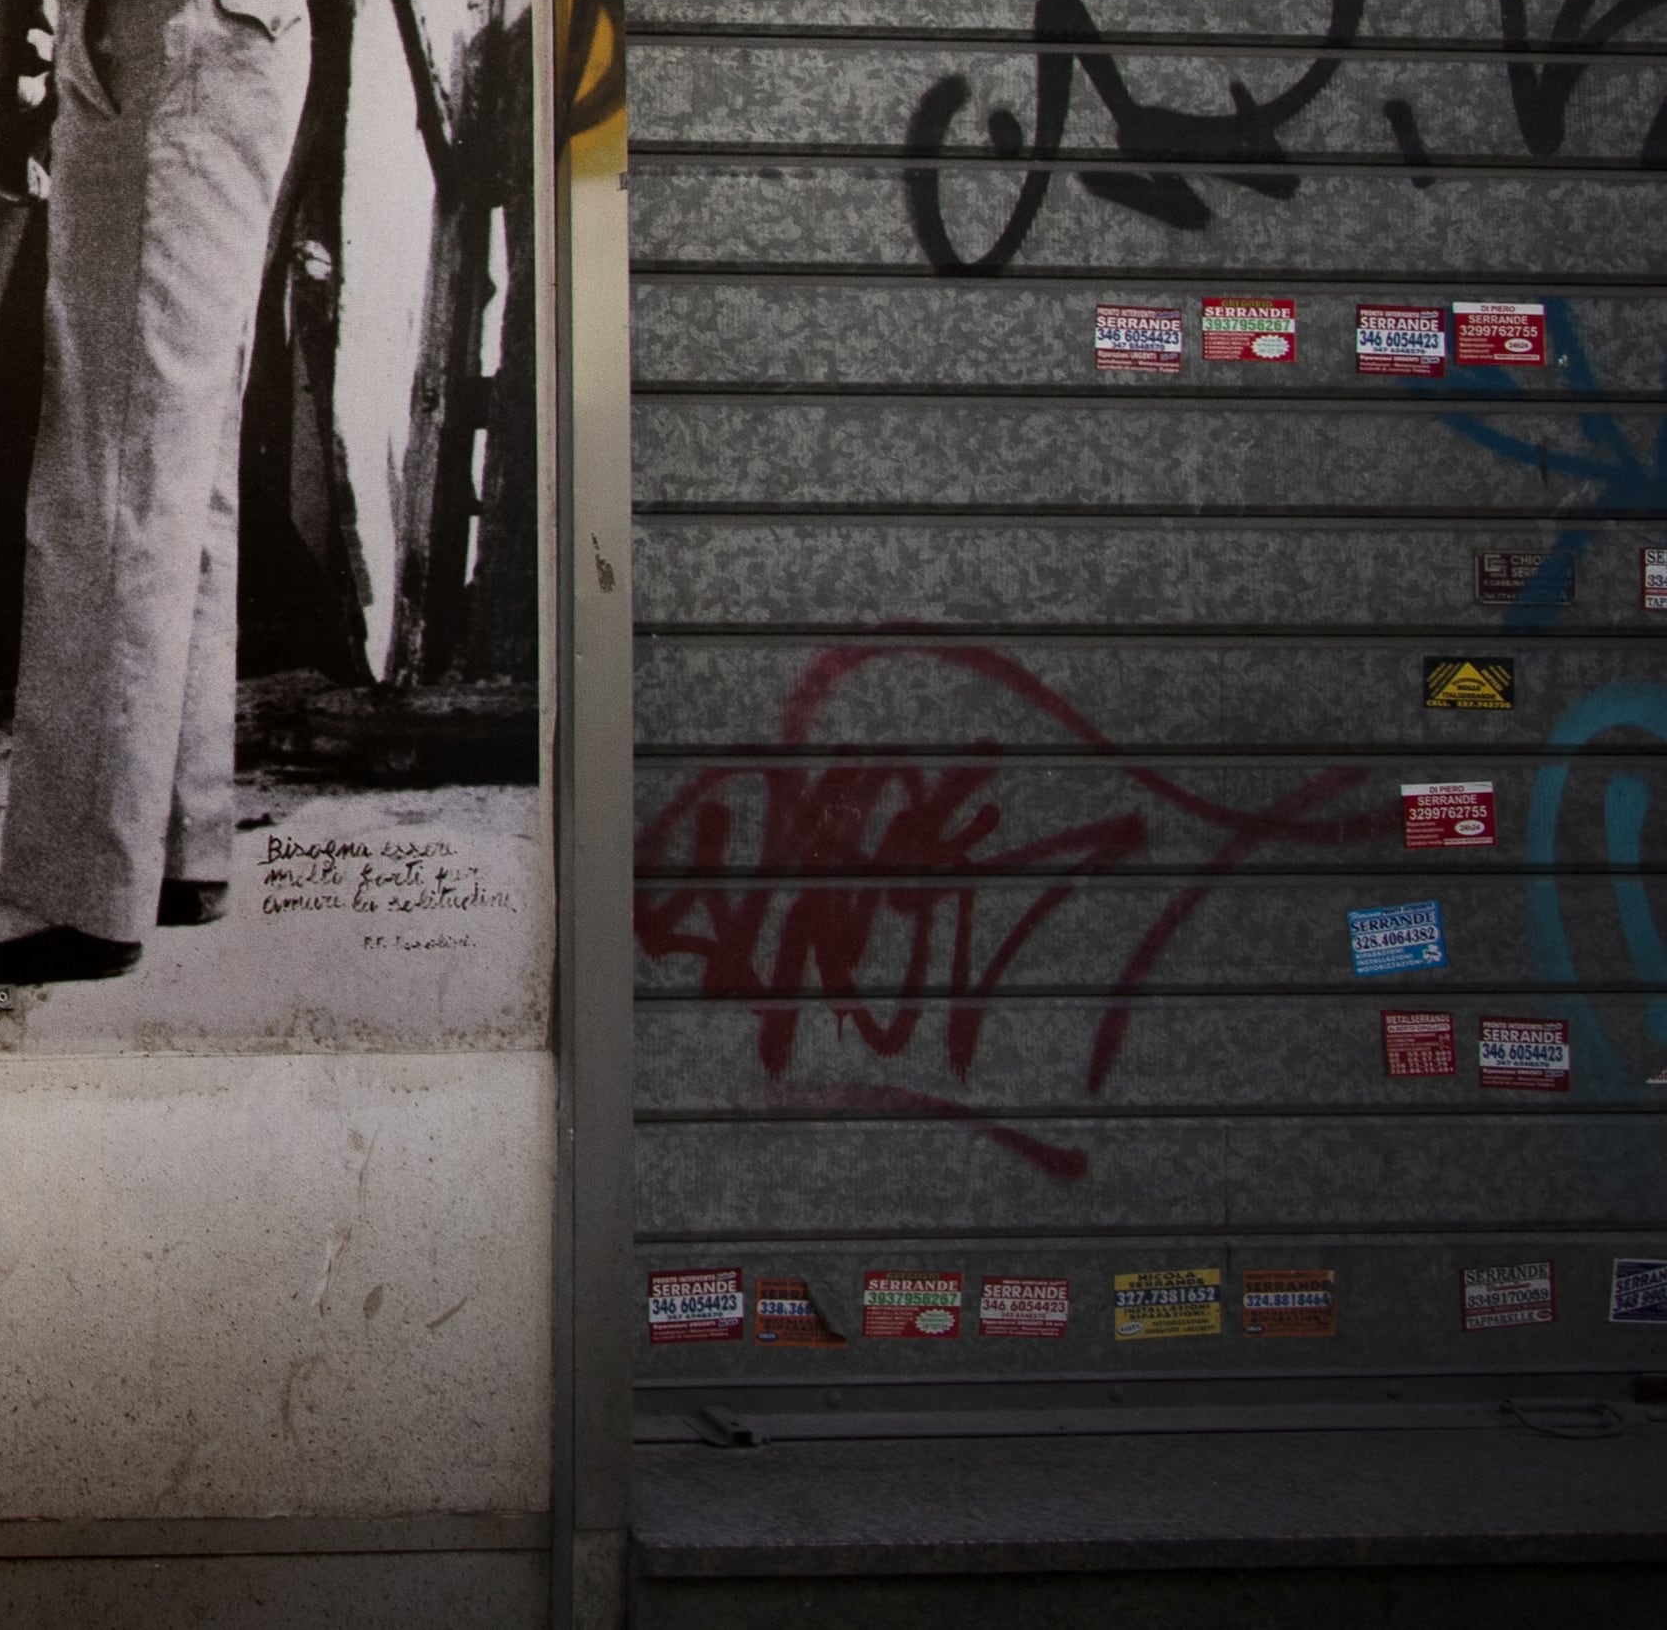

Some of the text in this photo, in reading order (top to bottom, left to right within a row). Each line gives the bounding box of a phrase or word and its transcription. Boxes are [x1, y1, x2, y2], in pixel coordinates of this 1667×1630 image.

[1204, 307, 1291, 319] SERRANDE
[1468, 315, 1528, 325] SERRANDE
[1097, 317, 1180, 330] SERRANDE
[1205, 319, 1290, 331] 3937956267
[1360, 318, 1438, 331] SERRANDE
[1098, 328, 1179, 344] 346 6054423
[1459, 325, 1538, 337] 3299762755
[1360, 331, 1438, 348] 346 6054423
[1417, 794, 1477, 806] SERRANDE
[1409, 806, 1487, 820] 3299762755
[257, 834, 373, 865] Bisogna
[1351, 912, 1434, 933] SERRANDE
[1355, 927, 1435, 950] 328.4064382
[1482, 1028, 1563, 1044] SERRANDE
[1482, 1043, 1563, 1062] 346 6054423
[1467, 1265, 1548, 1284] SERRANDE
[652, 1280, 737, 1297] SERRANDE
[868, 1280, 958, 1291] SERRANDE
[1130, 1278, 1205, 1288] SERRANDE
[1246, 1281, 1331, 1292] SERRANDE
[868, 1292, 958, 1305] 3937956267
[983, 1284, 1067, 1299] SERRANDE
[1117, 1287, 1215, 1307] 327.7381652
[1468, 1288, 1549, 1307] 3349170059
[652, 1295, 736, 1315] 346 6054423
[983, 1299, 1065, 1313] 346 6054423
